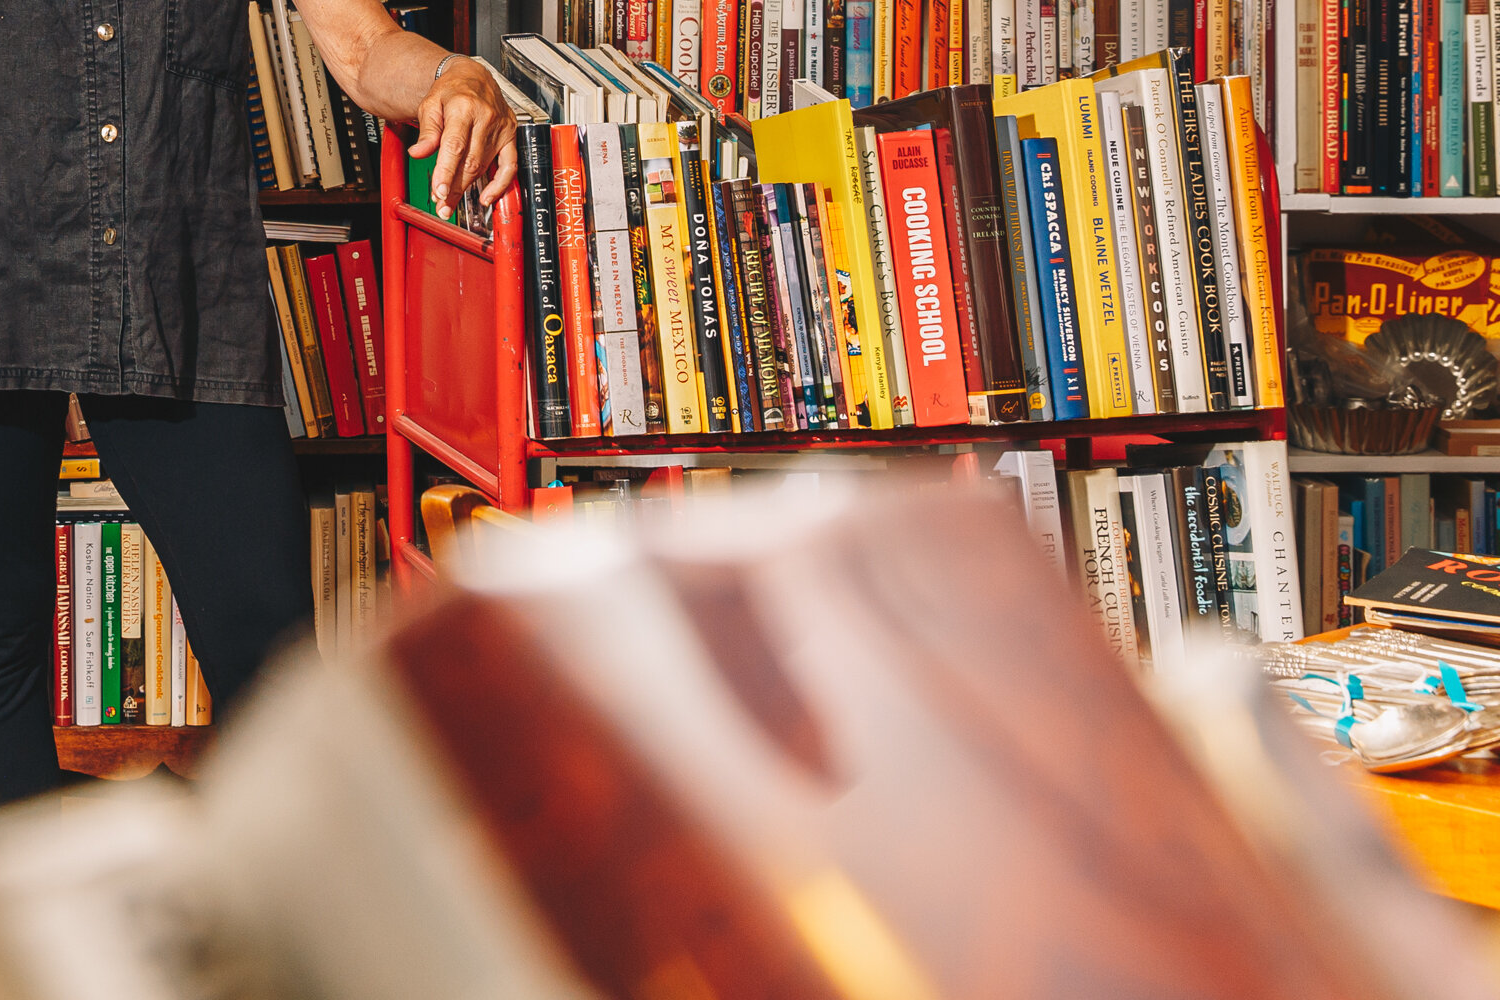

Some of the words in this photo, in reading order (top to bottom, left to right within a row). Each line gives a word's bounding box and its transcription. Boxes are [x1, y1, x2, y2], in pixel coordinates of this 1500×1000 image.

[1179, 69, 1194, 103] THE
[1326, 44, 1338, 91] OLNEY
[1078, 96, 1093, 139] LUMMI
[1150, 80, 1165, 119] Patrick
[1205, 101, 1217, 129] Recipes
[1328, 93, 1335, 107] on
[1183, 109, 1201, 155] FIRST
[1206, 131, 1220, 149] from
[1239, 107, 1252, 139] Anne
[1327, 109, 1338, 159] BREAD
[862, 151, 879, 195] SALLY
[1087, 149, 1095, 173] ISLAND
[1109, 140, 1120, 167] NEUE
[1156, 123, 1174, 196] O'Connell's
[1209, 152, 1222, 182] Giverny
[1243, 142, 1259, 183] Willan
[534, 183, 547, 202] the
[1040, 163, 1054, 189] Chi
[1089, 175, 1099, 207] COOKING
[1113, 170, 1124, 211] CUISINE
[1189, 161, 1209, 220] LADIES
[536, 208, 550, 236] food
[569, 168, 585, 247] AUTHENTIC
[1044, 192, 1062, 253] SPACCA
[1118, 214, 1127, 232] THE
[1165, 200, 1180, 245] Refined
[1216, 197, 1228, 217] The
[1247, 188, 1262, 220] From
[538, 242, 551, 264] and
[609, 237, 618, 266] MADE
[660, 224, 675, 251] MY
[693, 214, 710, 265] DOÑA
[869, 204, 891, 280] CLARKE'S
[902, 187, 936, 280] COOKING
[1092, 217, 1107, 266] BLAINE
[1196, 225, 1216, 279] COOK
[1218, 222, 1232, 258] Monet
[1249, 225, 1263, 245] My
[612, 270, 619, 281] IN
[1120, 235, 1132, 278] ELEGANT
[1254, 250, 1269, 301] Château
[540, 269, 554, 291] life
[664, 256, 681, 304] sweet
[745, 250, 765, 307] RECIPE
[1057, 269, 1070, 303] NANCY
[1170, 249, 1187, 306] American
[1222, 262, 1239, 324] Cookbook
[542, 297, 556, 309] of
[613, 284, 624, 325] MEXICO
[700, 275, 718, 339] TOMÁS
[749, 310, 768, 326] of
[880, 290, 897, 339] BOOK
[1099, 271, 1115, 326] WETZEL
[1125, 282, 1136, 316] TASTES
[1204, 284, 1222, 334] BOOK
[1314, 282, 1464, 316] Pan-O-Liner
[914, 284, 947, 366] SCHOOL
[1062, 306, 1077, 362] SILVERTON
[1129, 319, 1138, 332] OF
[1179, 310, 1191, 356] Cuisine
[1260, 306, 1274, 355] Kitchen
[543, 314, 563, 384] Oaxaca
[669, 310, 689, 384] MEXICO
[759, 331, 779, 398] MEMORY
[1131, 335, 1142, 370] VIENNA
[1234, 356, 1244, 392] PRESTEL
[1184, 486, 1199, 507] the
[1204, 476, 1220, 532] COSMIC
[85, 543, 94, 576] Kosher
[122, 534, 130, 579] KOSHER
[1187, 509, 1209, 572] accidental
[130, 543, 140, 582] HELEN
[1210, 534, 1228, 592] CUISINE
[85, 578, 94, 610] Nation
[122, 581, 131, 634] KITCHEN
[130, 586, 140, 625] NASH'S
[1194, 575, 1212, 615] foodie
[85, 631, 94, 648] Sue
[85, 651, 94, 688] Fishkoff
